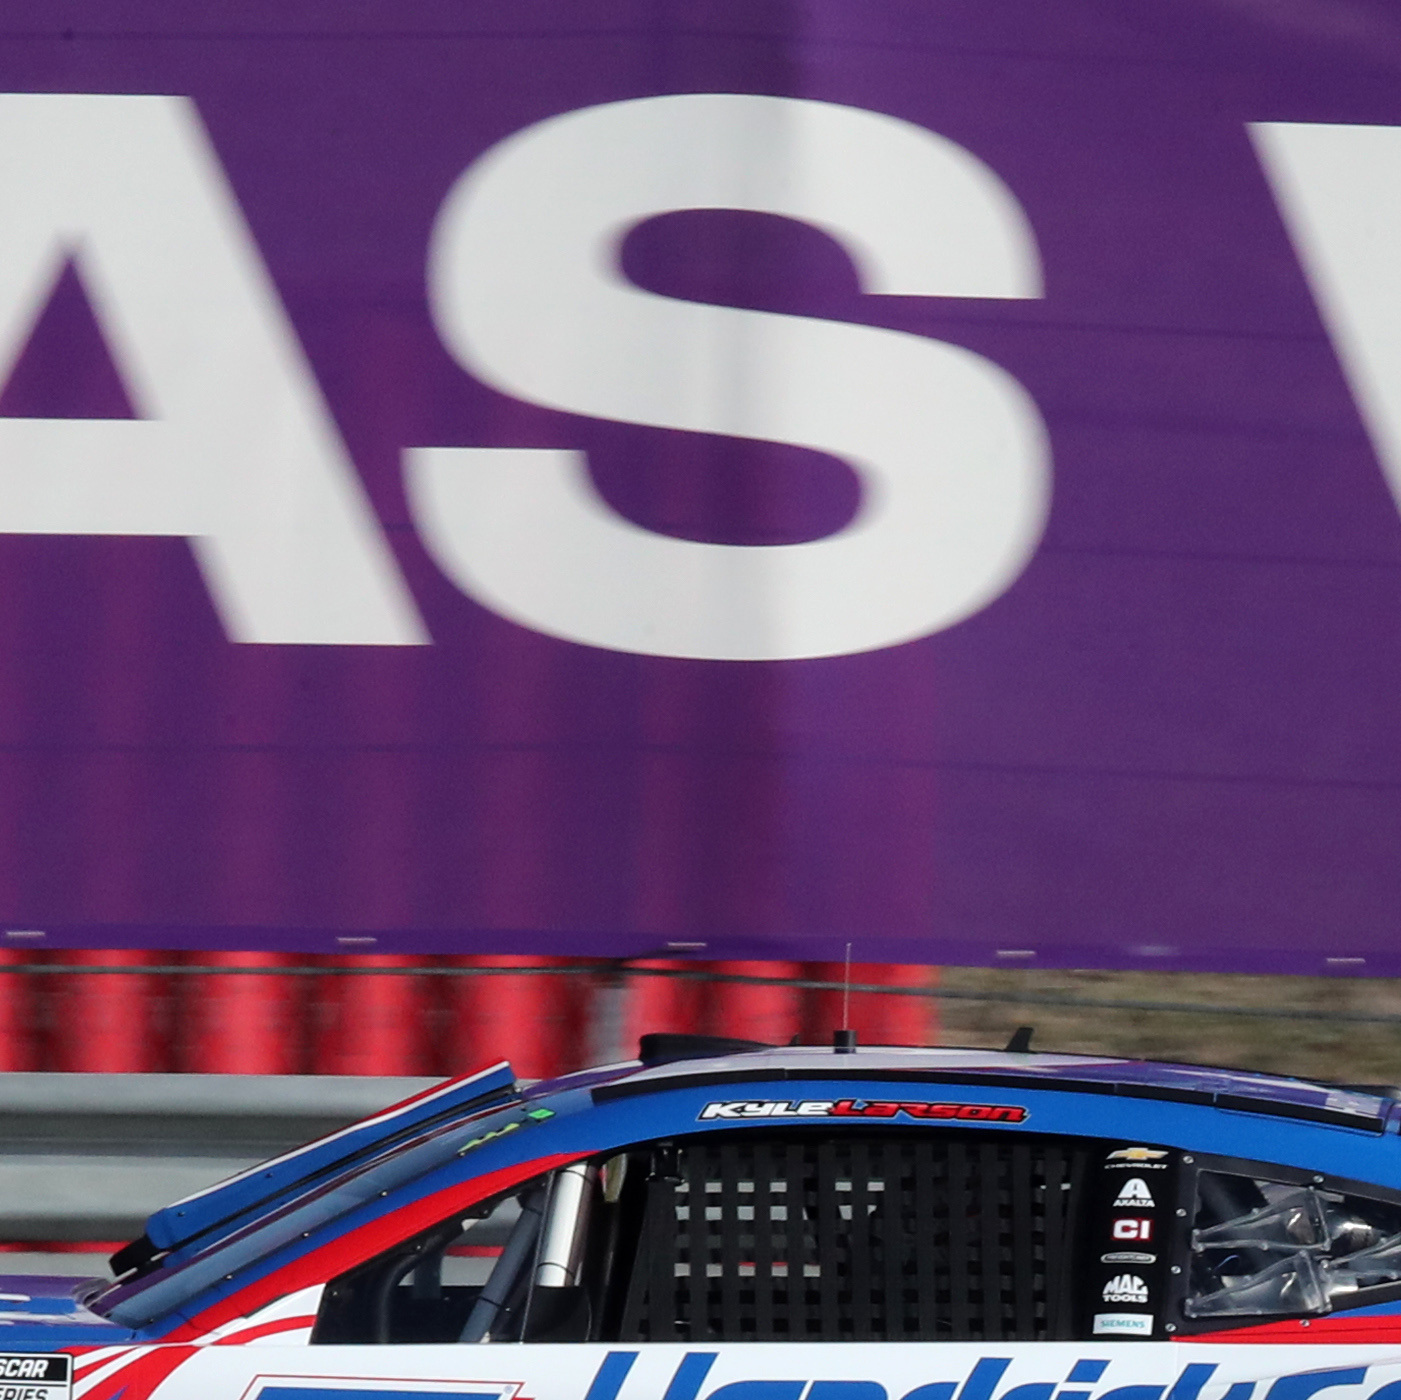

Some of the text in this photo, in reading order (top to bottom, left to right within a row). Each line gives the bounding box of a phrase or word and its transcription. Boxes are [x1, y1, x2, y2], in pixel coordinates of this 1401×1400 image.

[1112, 1199, 1156, 1208] AXALTA
[1112, 1219, 1150, 1240] CI
[1102, 1273, 1149, 1295] MAC
[1102, 1294, 1149, 1304] TOOLS
[1100, 1319, 1146, 1328] SIEMENS
